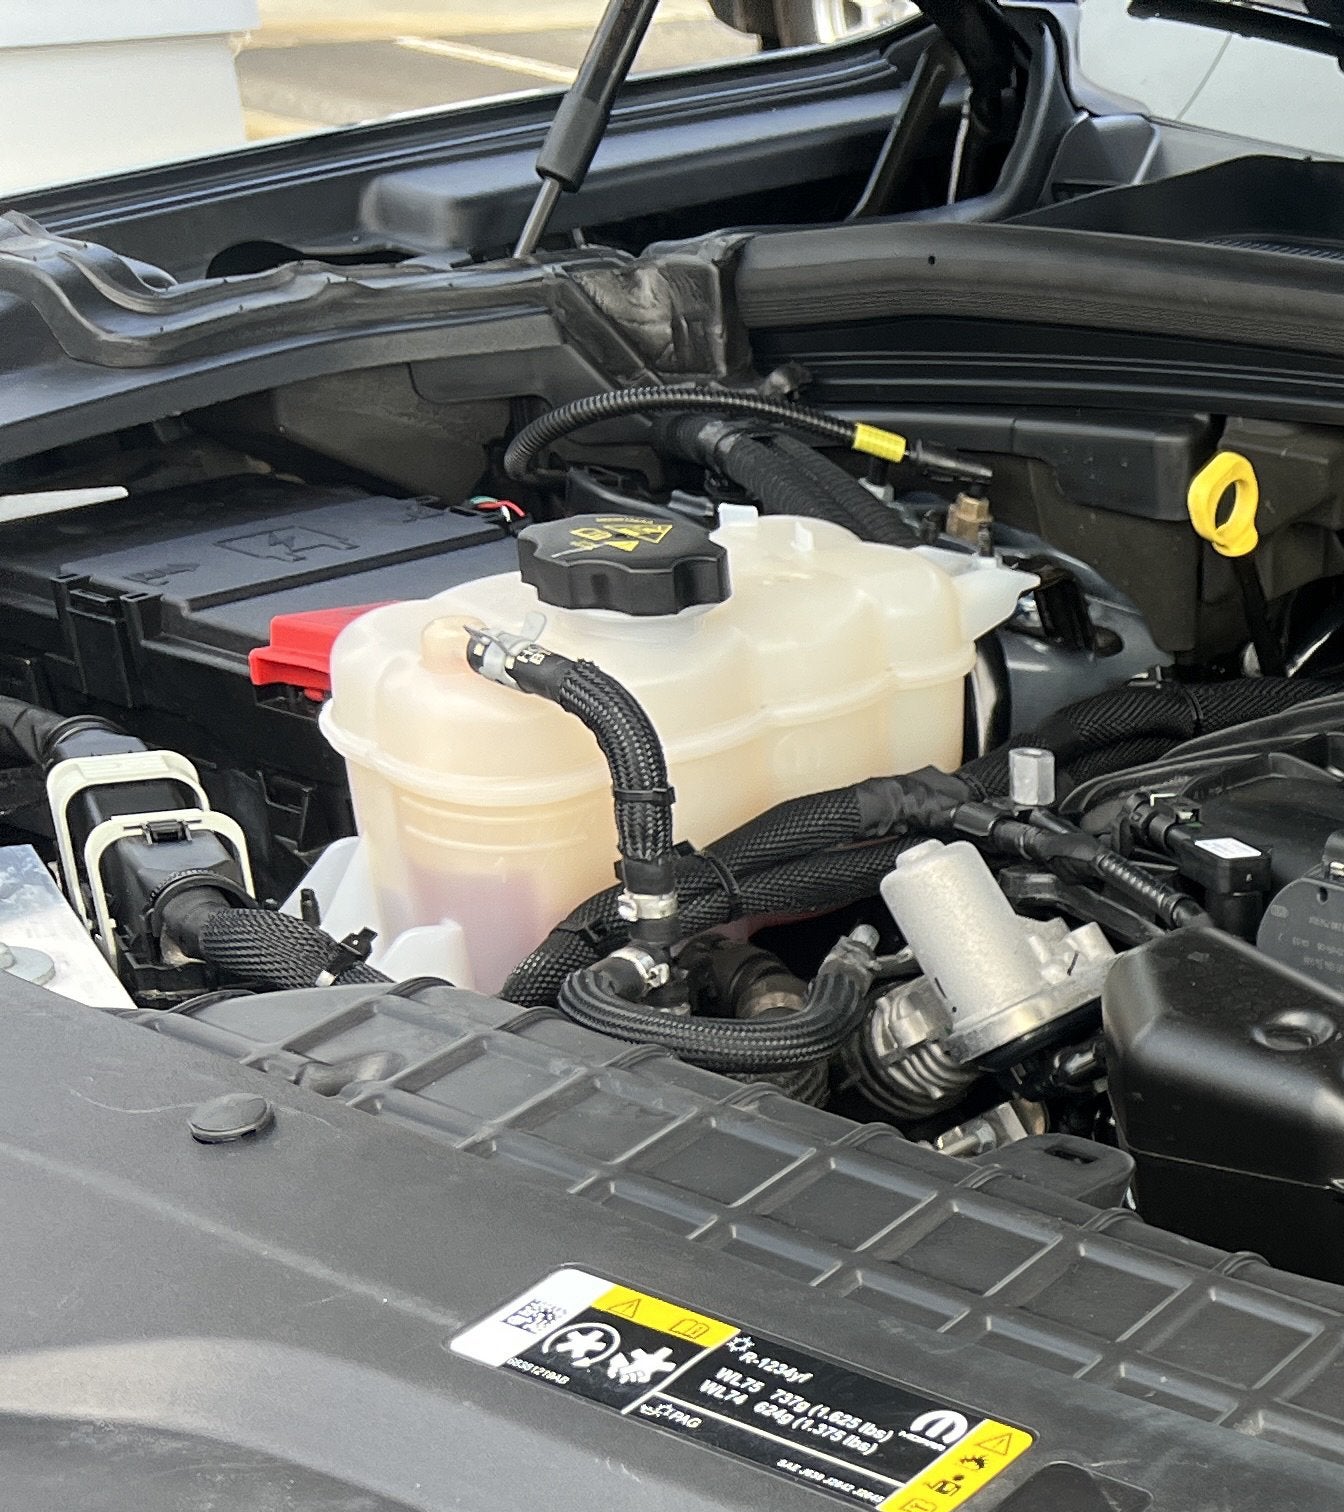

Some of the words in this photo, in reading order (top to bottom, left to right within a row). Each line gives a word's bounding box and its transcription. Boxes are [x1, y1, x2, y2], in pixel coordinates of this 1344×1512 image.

[739, 1351, 814, 1383] R-1234yf
[671, 1409, 703, 1429] PAG
[699, 1379, 749, 1405] WL74
[753, 1401, 795, 1426] 624g
[791, 1416, 847, 1442] (1.375
[842, 1434, 879, 1456] lbs)
[715, 1366, 766, 1393] WL75
[770, 1388, 811, 1413] 737g
[807, 1403, 863, 1429] (1.625
[858, 1420, 895, 1444] lbs)
